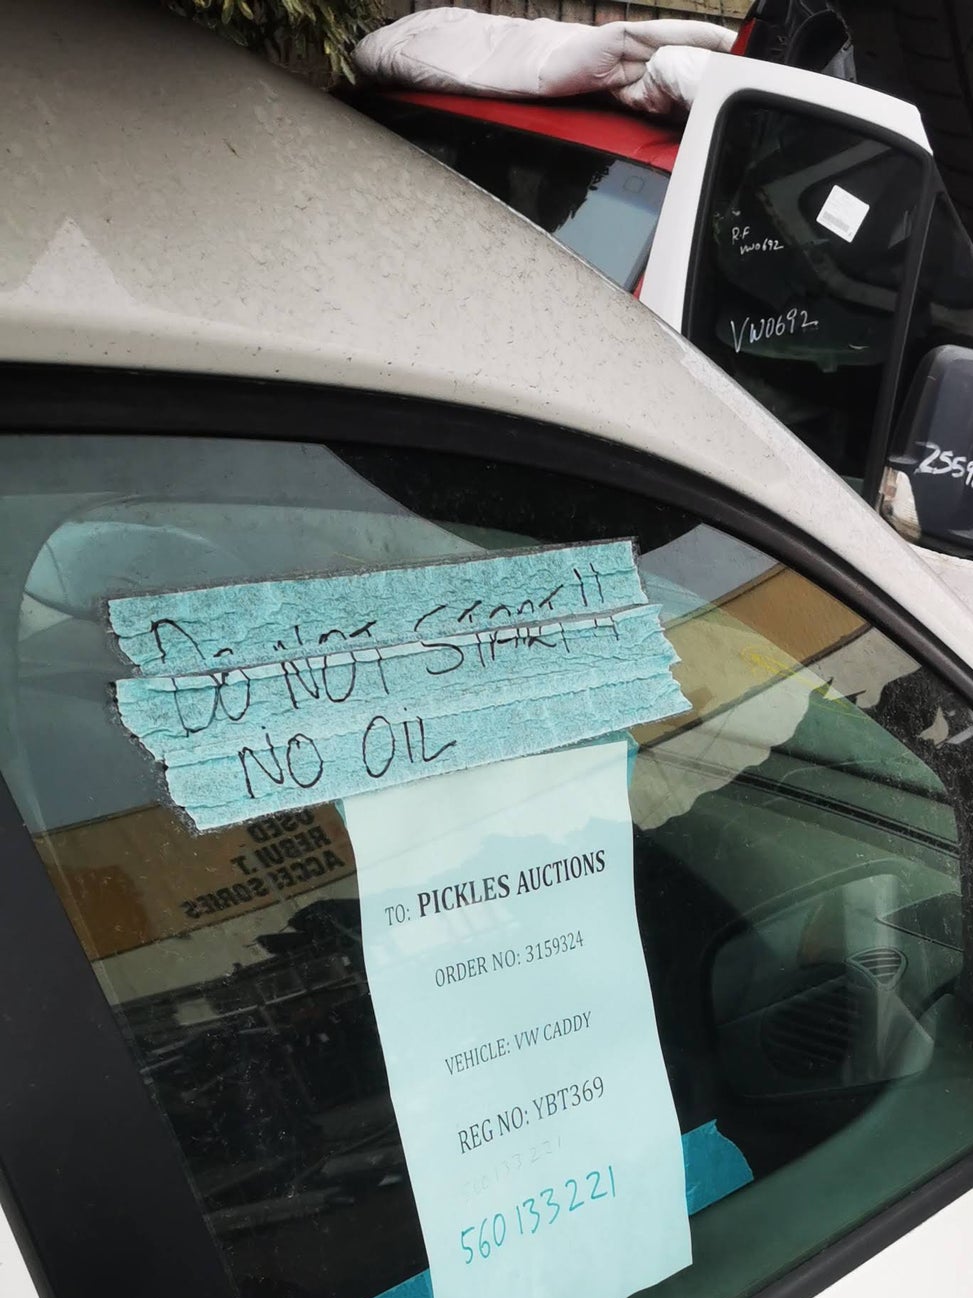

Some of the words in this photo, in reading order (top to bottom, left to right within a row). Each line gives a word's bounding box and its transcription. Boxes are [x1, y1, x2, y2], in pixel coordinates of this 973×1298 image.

[239, 732, 324, 799] NO
[363, 715, 457, 779] OIL
[384, 903, 412, 926] TO:
[417, 874, 511, 918] PICKLES
[516, 849, 606, 895] AUCTIONS
[435, 956, 488, 988] ORDER
[492, 949, 521, 972] NO:
[525, 930, 585, 963] 3159324
[445, 1038, 511, 1076] VEHICLE:
[514, 1028, 540, 1051] VW
[543, 1011, 592, 1041] CADDY
[458, 1119, 494, 1154] REG
[497, 1106, 530, 1136] NO:
[532, 1076, 604, 1121] YBT369
